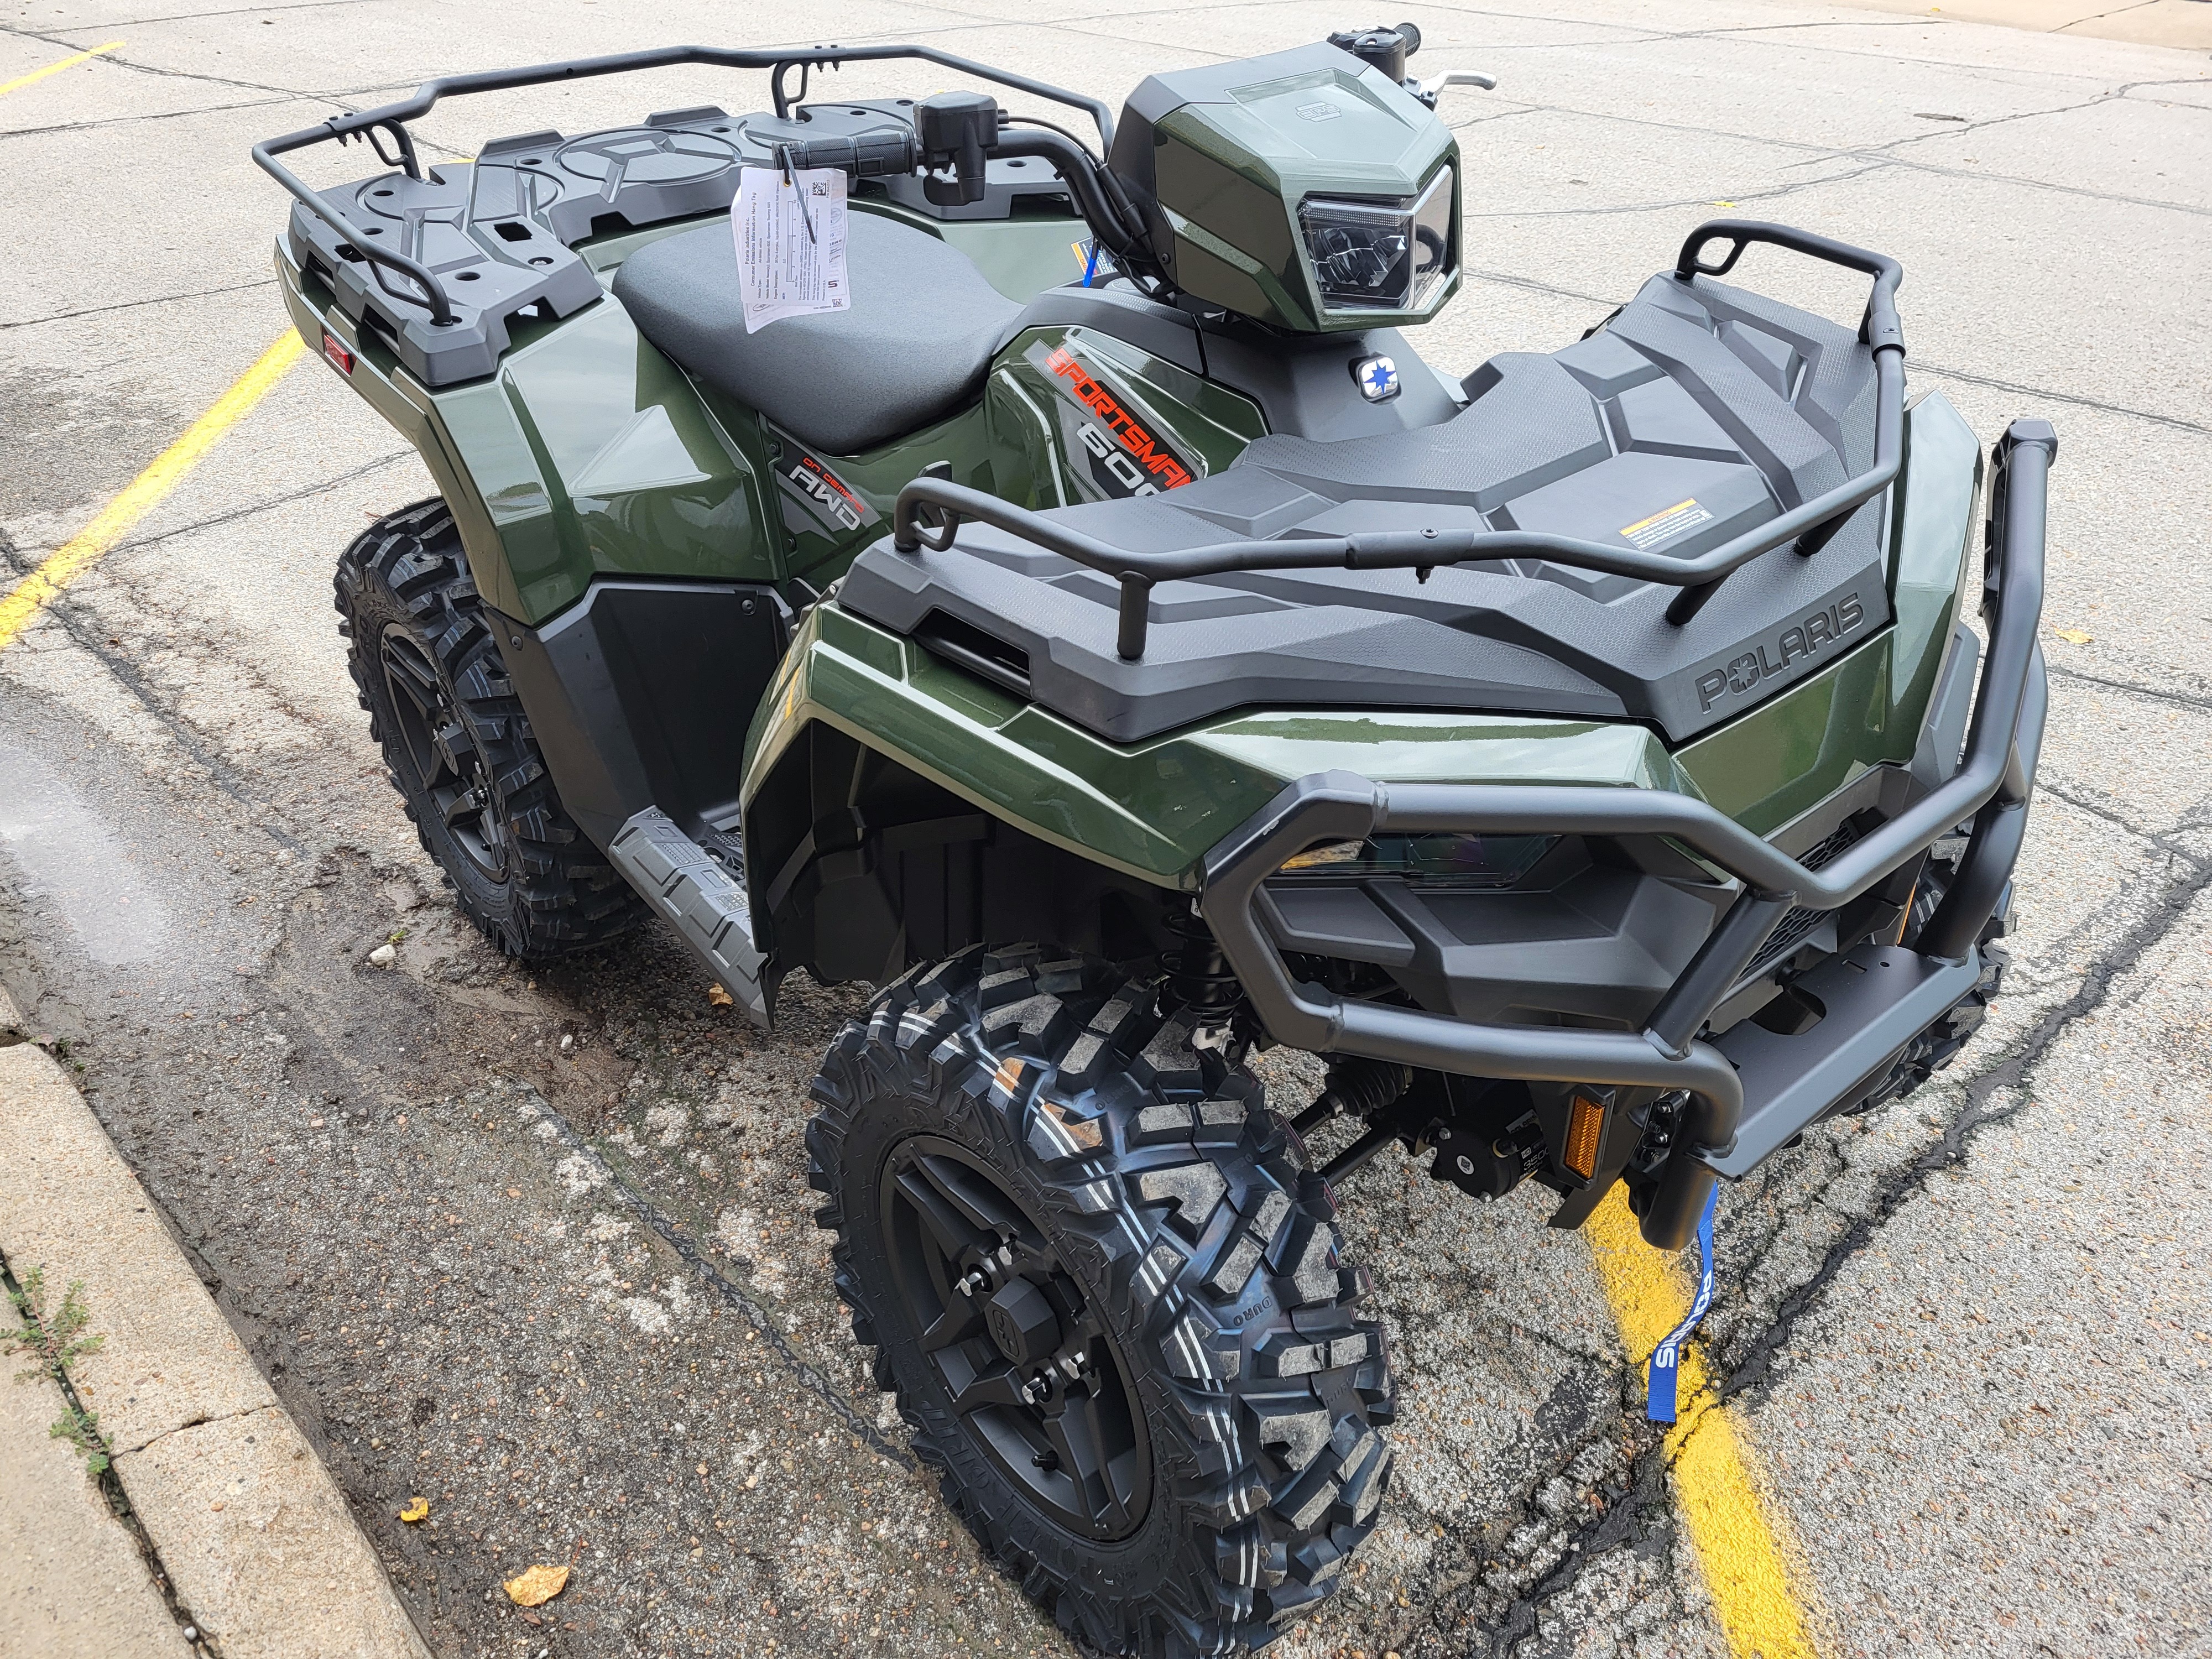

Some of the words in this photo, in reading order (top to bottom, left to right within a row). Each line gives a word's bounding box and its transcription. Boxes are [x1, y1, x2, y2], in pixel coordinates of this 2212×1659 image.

[1296, 103, 1341, 119] EPS
[789, 465, 860, 531] AWD
[1695, 592, 1864, 714] POLARIS
[1522, 1149, 1531, 1157] HD
[1233, 1296, 1272, 1327] DURO
[1655, 1269, 1712, 1368] POLARIS
